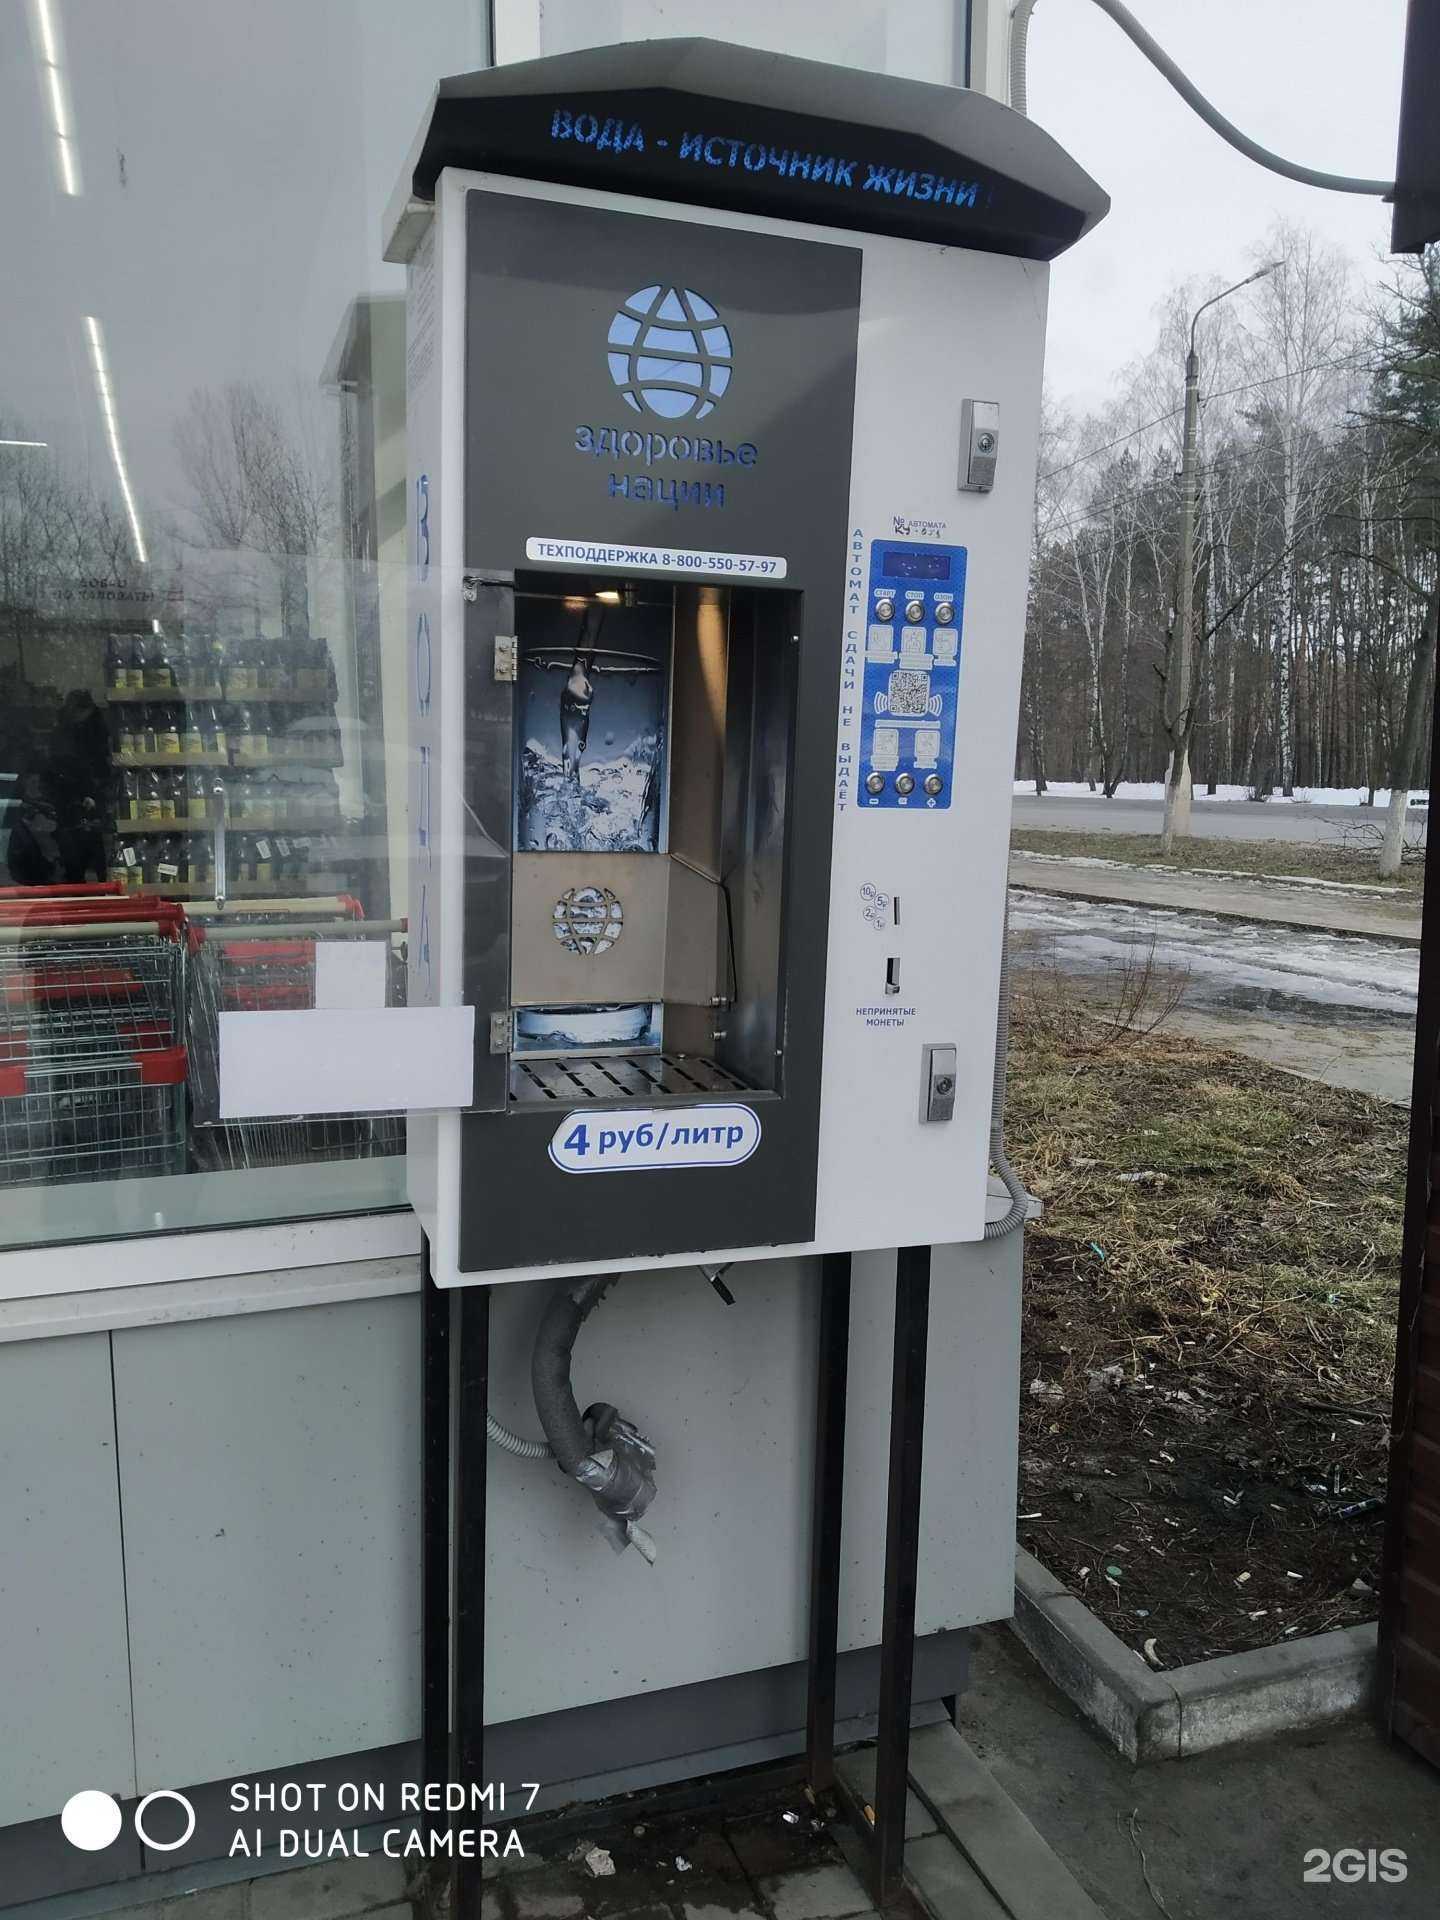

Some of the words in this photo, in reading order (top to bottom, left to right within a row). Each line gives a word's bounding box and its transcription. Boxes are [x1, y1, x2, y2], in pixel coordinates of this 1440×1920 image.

[551, 109, 645, 154] ВОДА
[679, 131, 858, 188] ИСТОЧНИК
[863, 162, 979, 209] ЖИЗНИ
[909, 520, 947, 529] АВТОМАТА
[537, 543, 658, 565] ТЕХПОДДЕРЖКА
[662, 553, 777, 574] 8-800-550-57-97
[849, 528, 864, 615] АВТОМАТ
[844, 630, 858, 690] СДАЧИ
[842, 706, 853, 727] НЕ
[856, 1007, 916, 1016] НЕПРИНЯТЫЕ
[866, 1018, 905, 1027] МОНЕТЫ
[564, 1124, 591, 1156] 4
[599, 1122, 744, 1155] руб/литр
